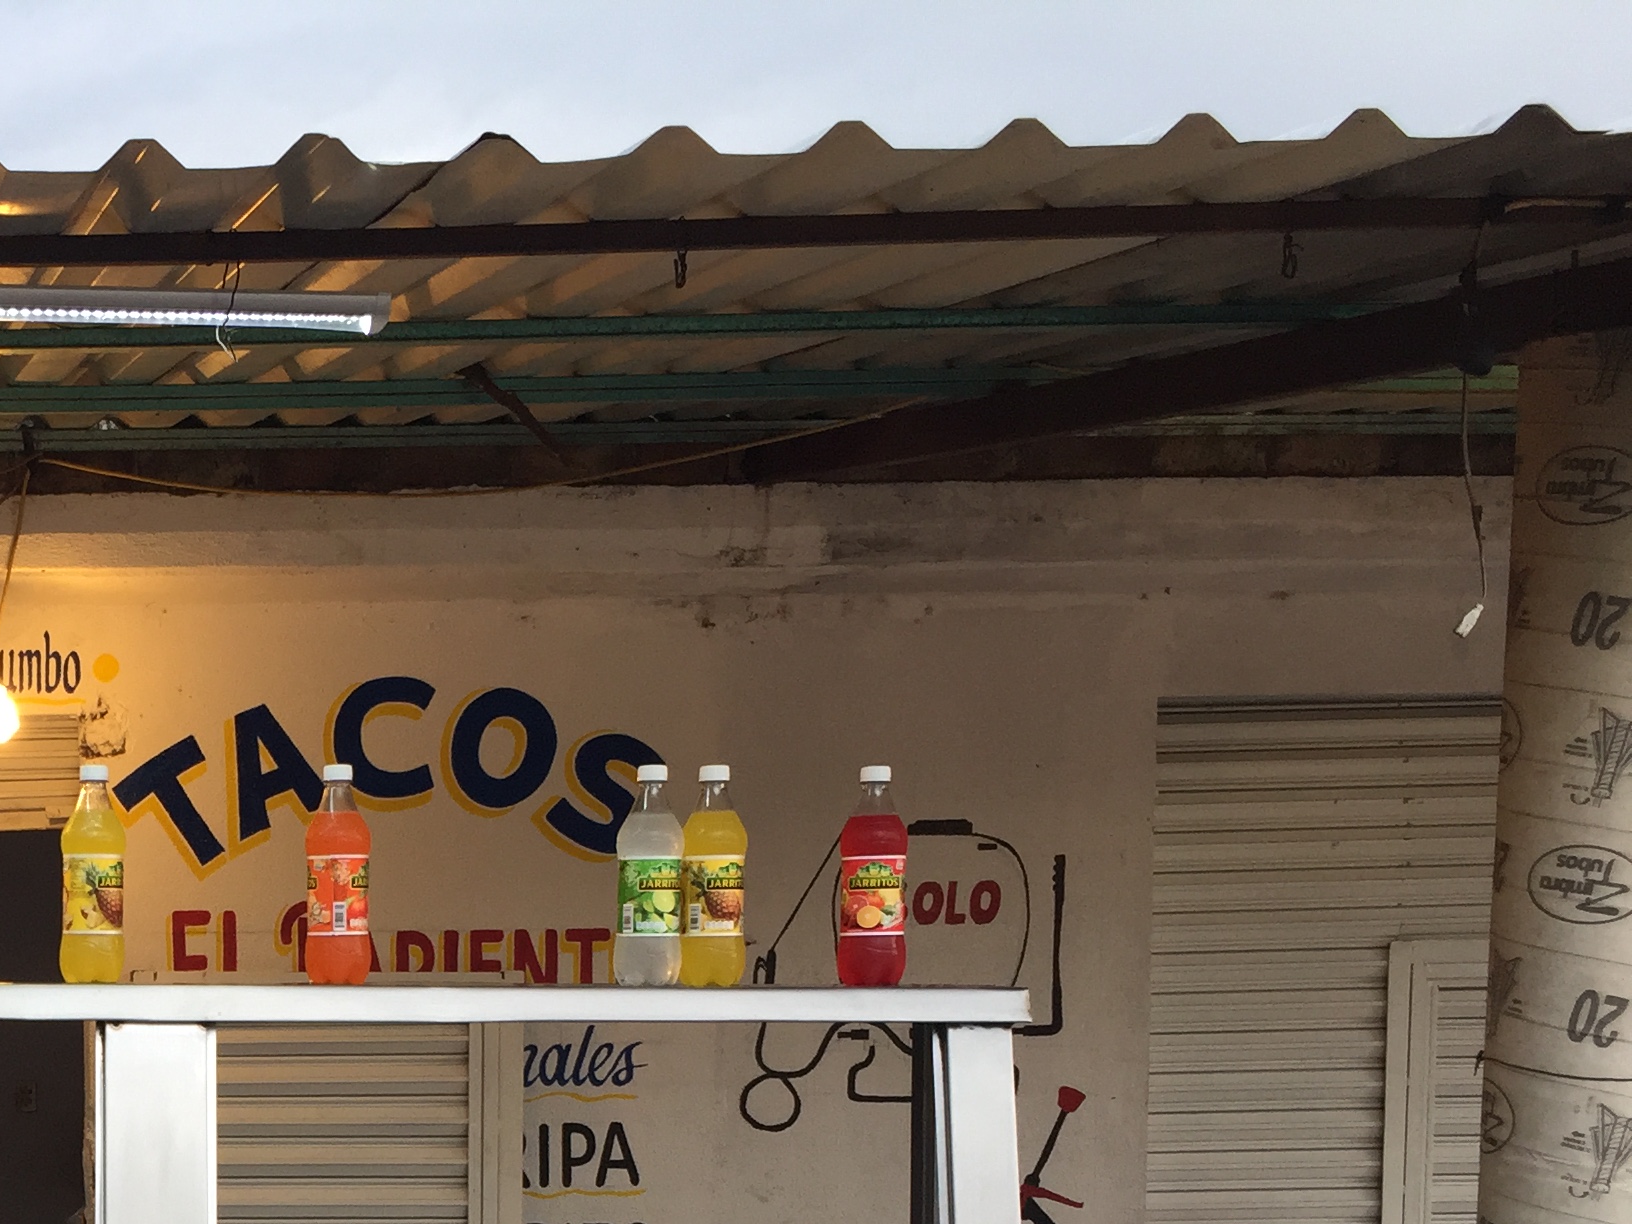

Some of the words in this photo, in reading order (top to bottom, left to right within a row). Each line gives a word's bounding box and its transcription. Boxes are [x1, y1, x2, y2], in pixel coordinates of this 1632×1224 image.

[1570, 591, 1630, 651] 20
[114, 675, 670, 872] TACOS
[850, 877, 899, 889] JARRITOS
[1556, 853, 1614, 884] Tubos
[905, 880, 1002, 926] OLO
[1537, 875, 1629, 916] Zimbra
[1566, 989, 1629, 1049] 20
